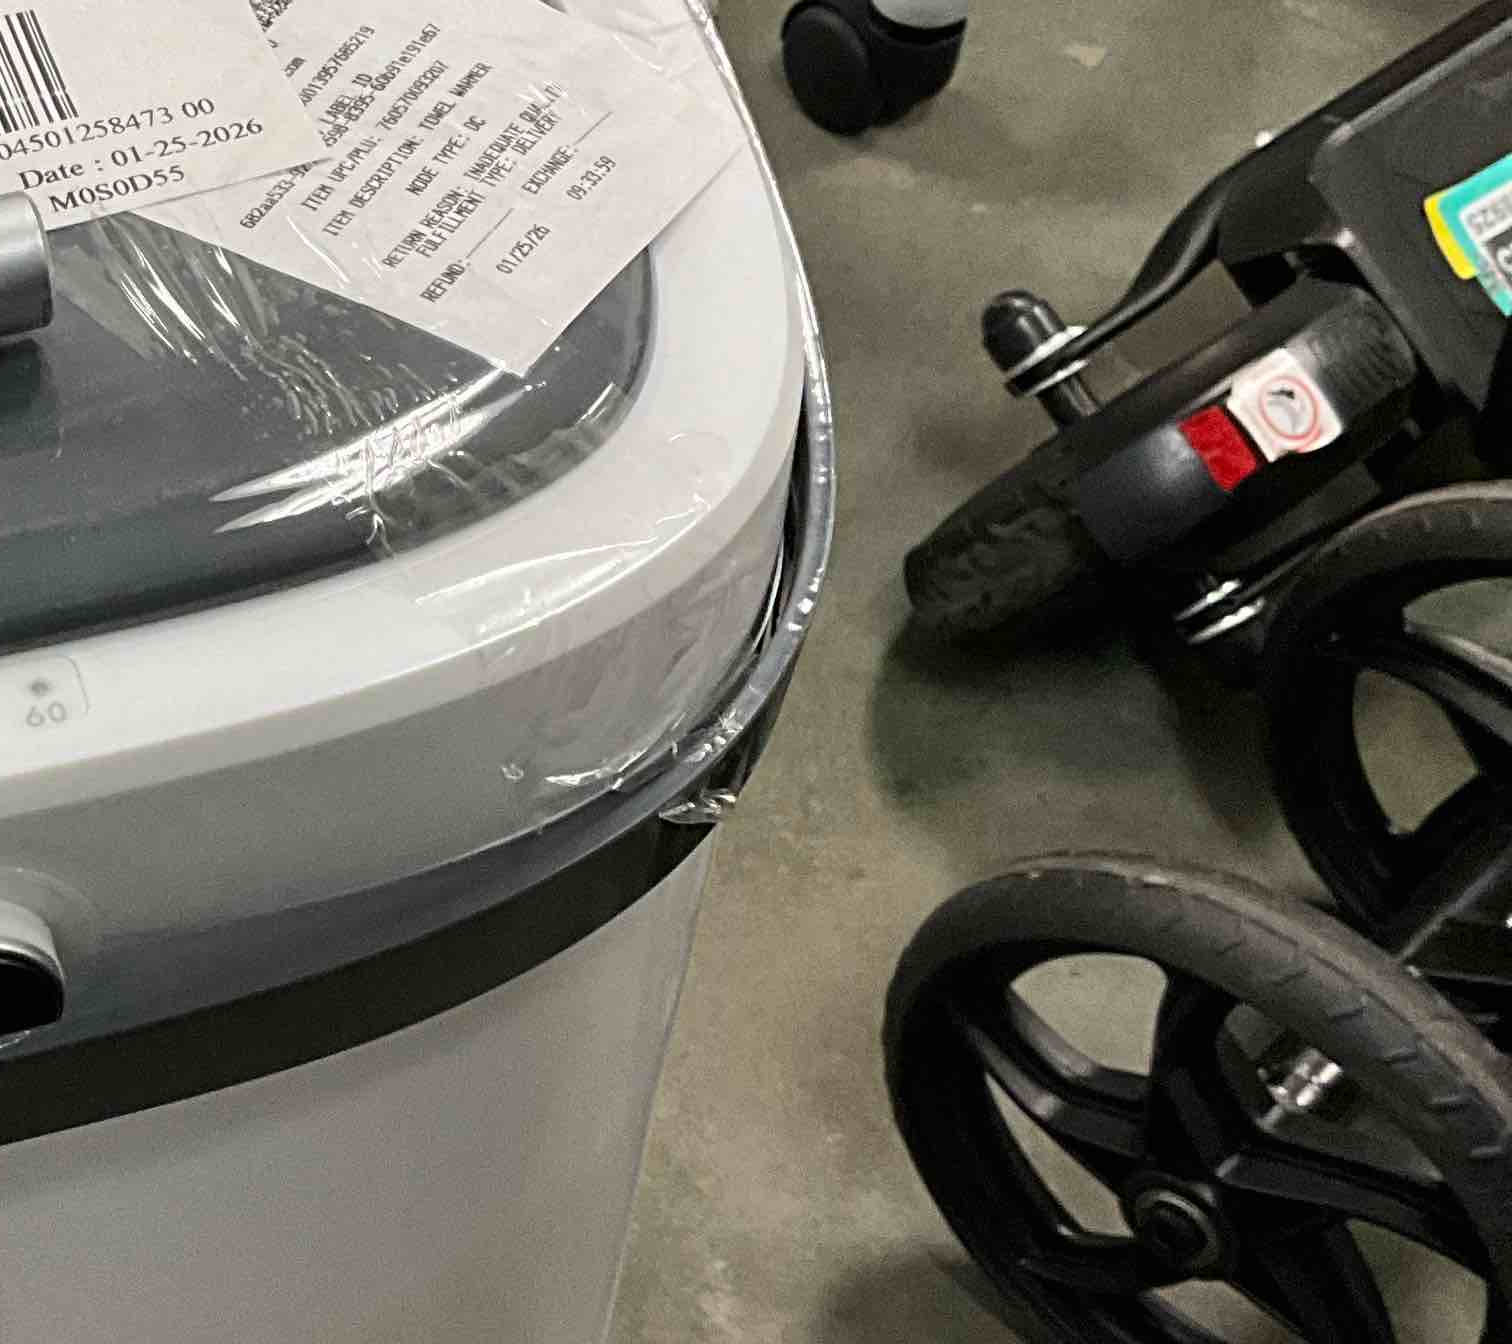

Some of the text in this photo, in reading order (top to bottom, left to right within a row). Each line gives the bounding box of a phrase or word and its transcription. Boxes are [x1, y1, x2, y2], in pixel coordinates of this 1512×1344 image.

[181, 97, 216, 119] 00
[321, 57, 493, 240] ITEM DESCRIPTION: TOWEL WARMER
[18, 162, 85, 191] Date
[110, 118, 264, 168] 01-25-2026
[300, 179, 335, 214] ITEM
[381, 225, 426, 271] RETURN
[420, 181, 468, 230] REASON:
[462, 121, 524, 185] INADEQUATE
[405, 163, 439, 198] NODE
[432, 129, 471, 168] TYPE:
[415, 188, 485, 261] FULFILLMENT
[478, 152, 518, 192] TYPE:
[419, 139, 578, 305] REFUND: EXCHANGE:
[494, 152, 617, 278] 01/25/26 09:33:59
[25, 701, 69, 728] 60
